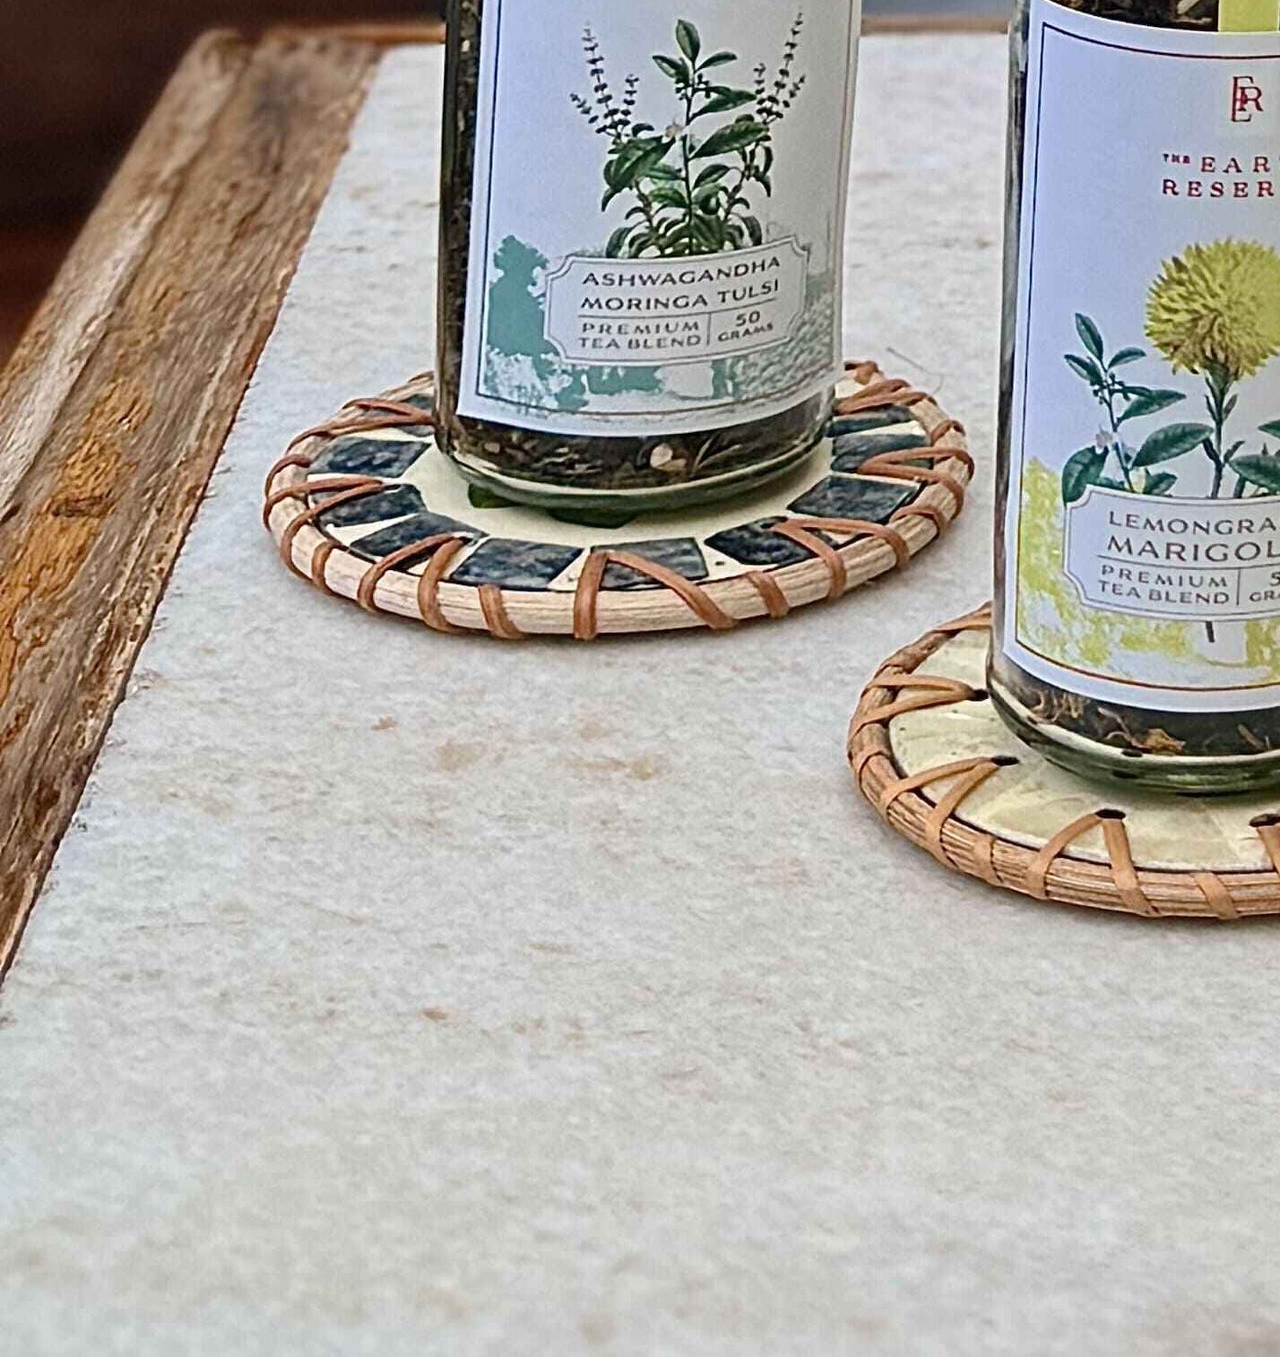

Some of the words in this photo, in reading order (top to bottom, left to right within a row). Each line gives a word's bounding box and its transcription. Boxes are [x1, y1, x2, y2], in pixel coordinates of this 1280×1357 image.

[1161, 152, 1192, 165] THE
[581, 255, 781, 287] ASHWAGANDHA
[579, 295, 709, 312] MORINGA
[716, 278, 780, 304] TULSI
[580, 320, 701, 336] PREMIUM
[734, 310, 762, 327] 50
[577, 336, 622, 350] TEA
[626, 335, 702, 350] BLEND
[716, 321, 775, 344] GRAMS
[1099, 563, 1229, 588] PREMIUM
[1097, 579, 1142, 601] TEA
[1147, 584, 1231, 606] BLEND
